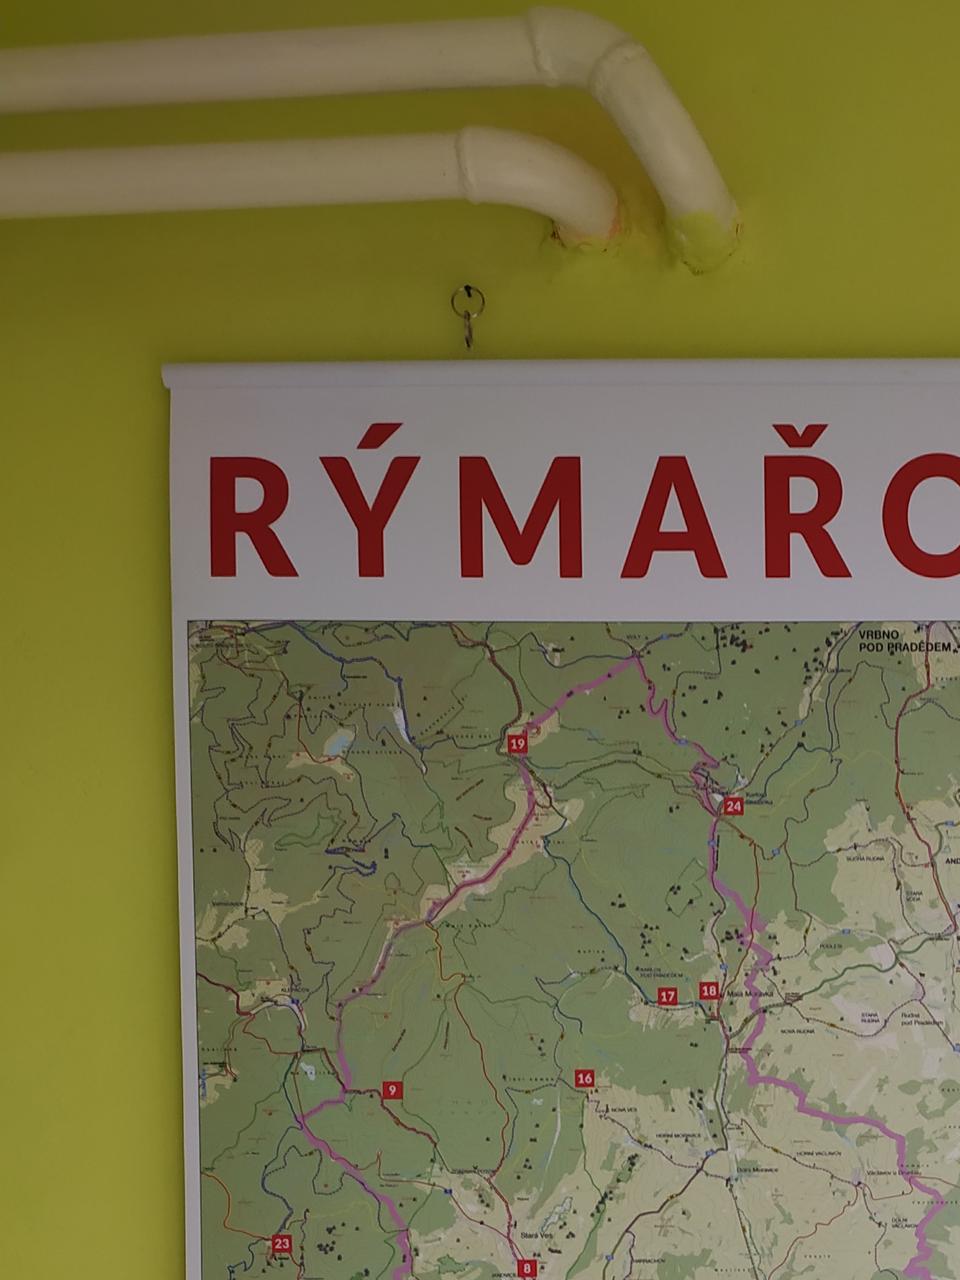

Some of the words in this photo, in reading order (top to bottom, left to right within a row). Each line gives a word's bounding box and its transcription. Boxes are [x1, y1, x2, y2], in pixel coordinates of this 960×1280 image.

[859, 630, 899, 640] VRBNO
[859, 643, 884, 652] POD
[888, 640, 951, 652] PRADĚDEM
